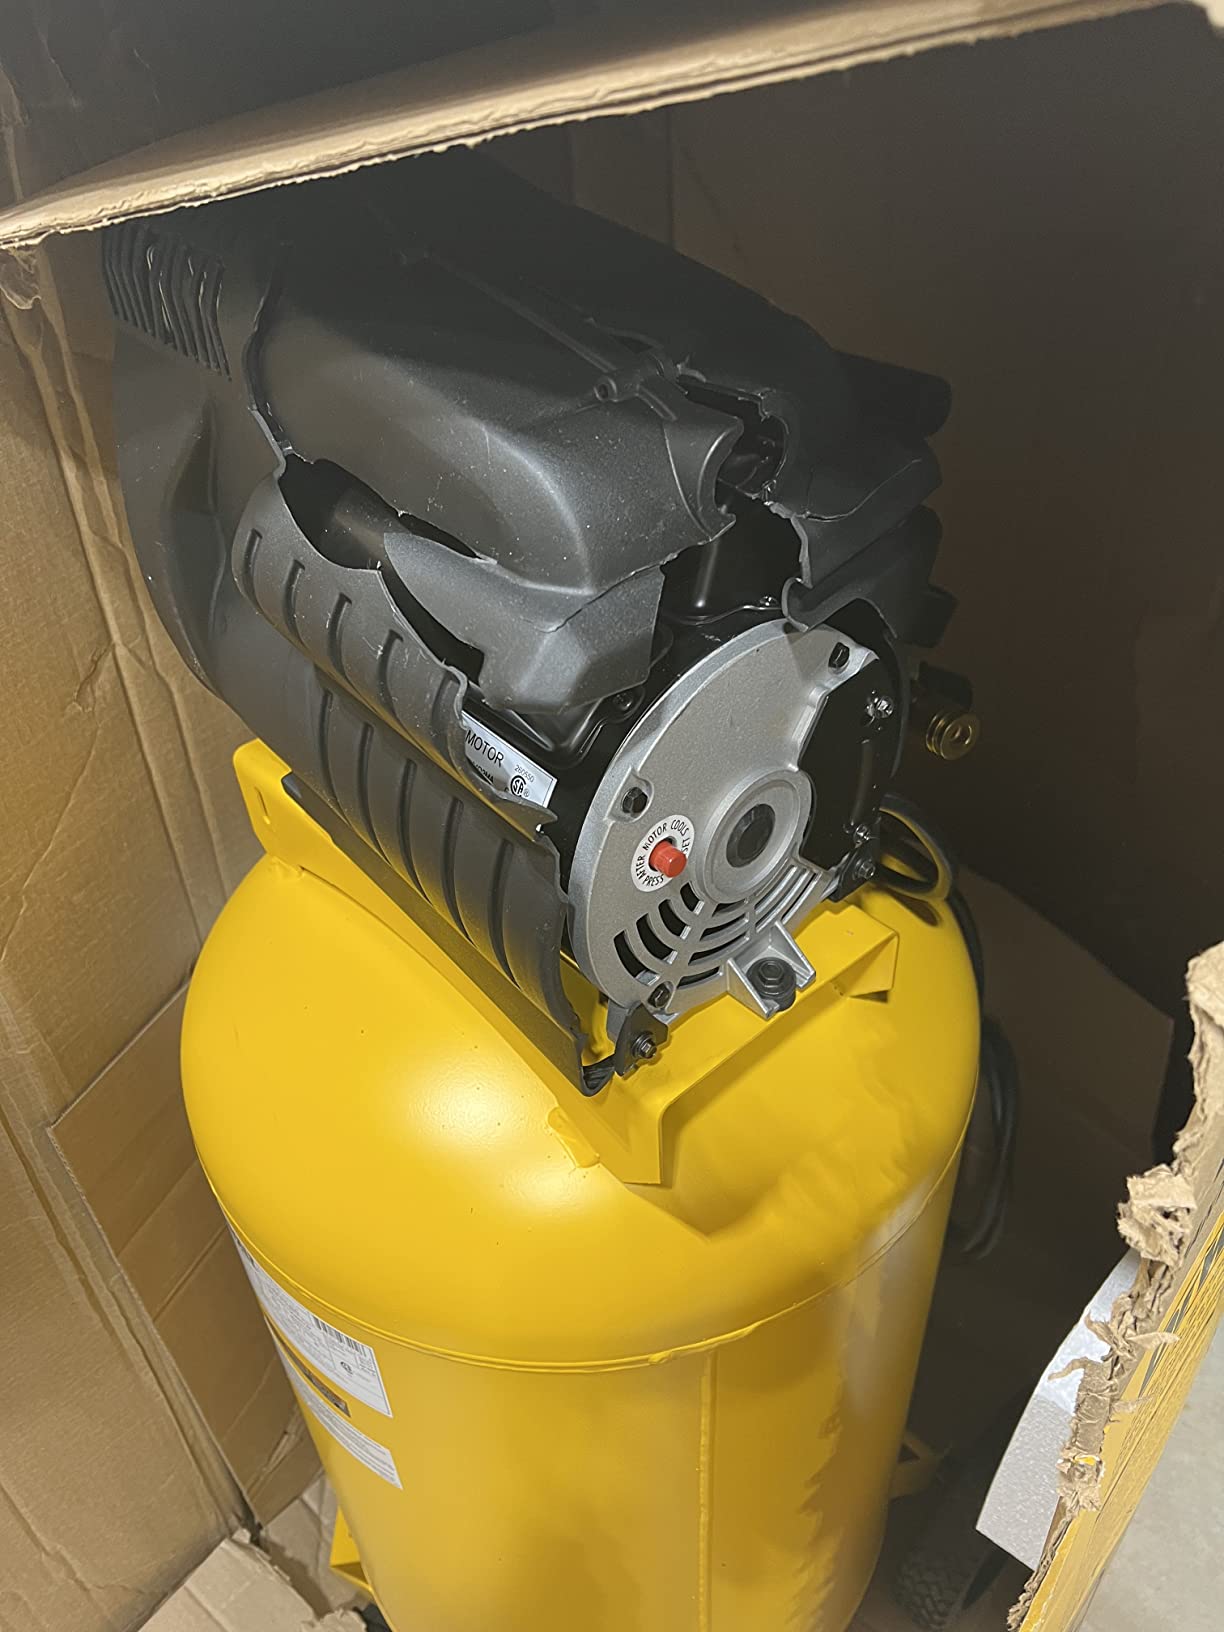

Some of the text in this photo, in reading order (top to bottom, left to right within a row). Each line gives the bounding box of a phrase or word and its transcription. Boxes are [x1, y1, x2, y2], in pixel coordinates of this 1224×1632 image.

[465, 729, 504, 767] MOTOR
[635, 819, 690, 880] AFTER MOTOR COOLS
[642, 873, 665, 887] PRESS
